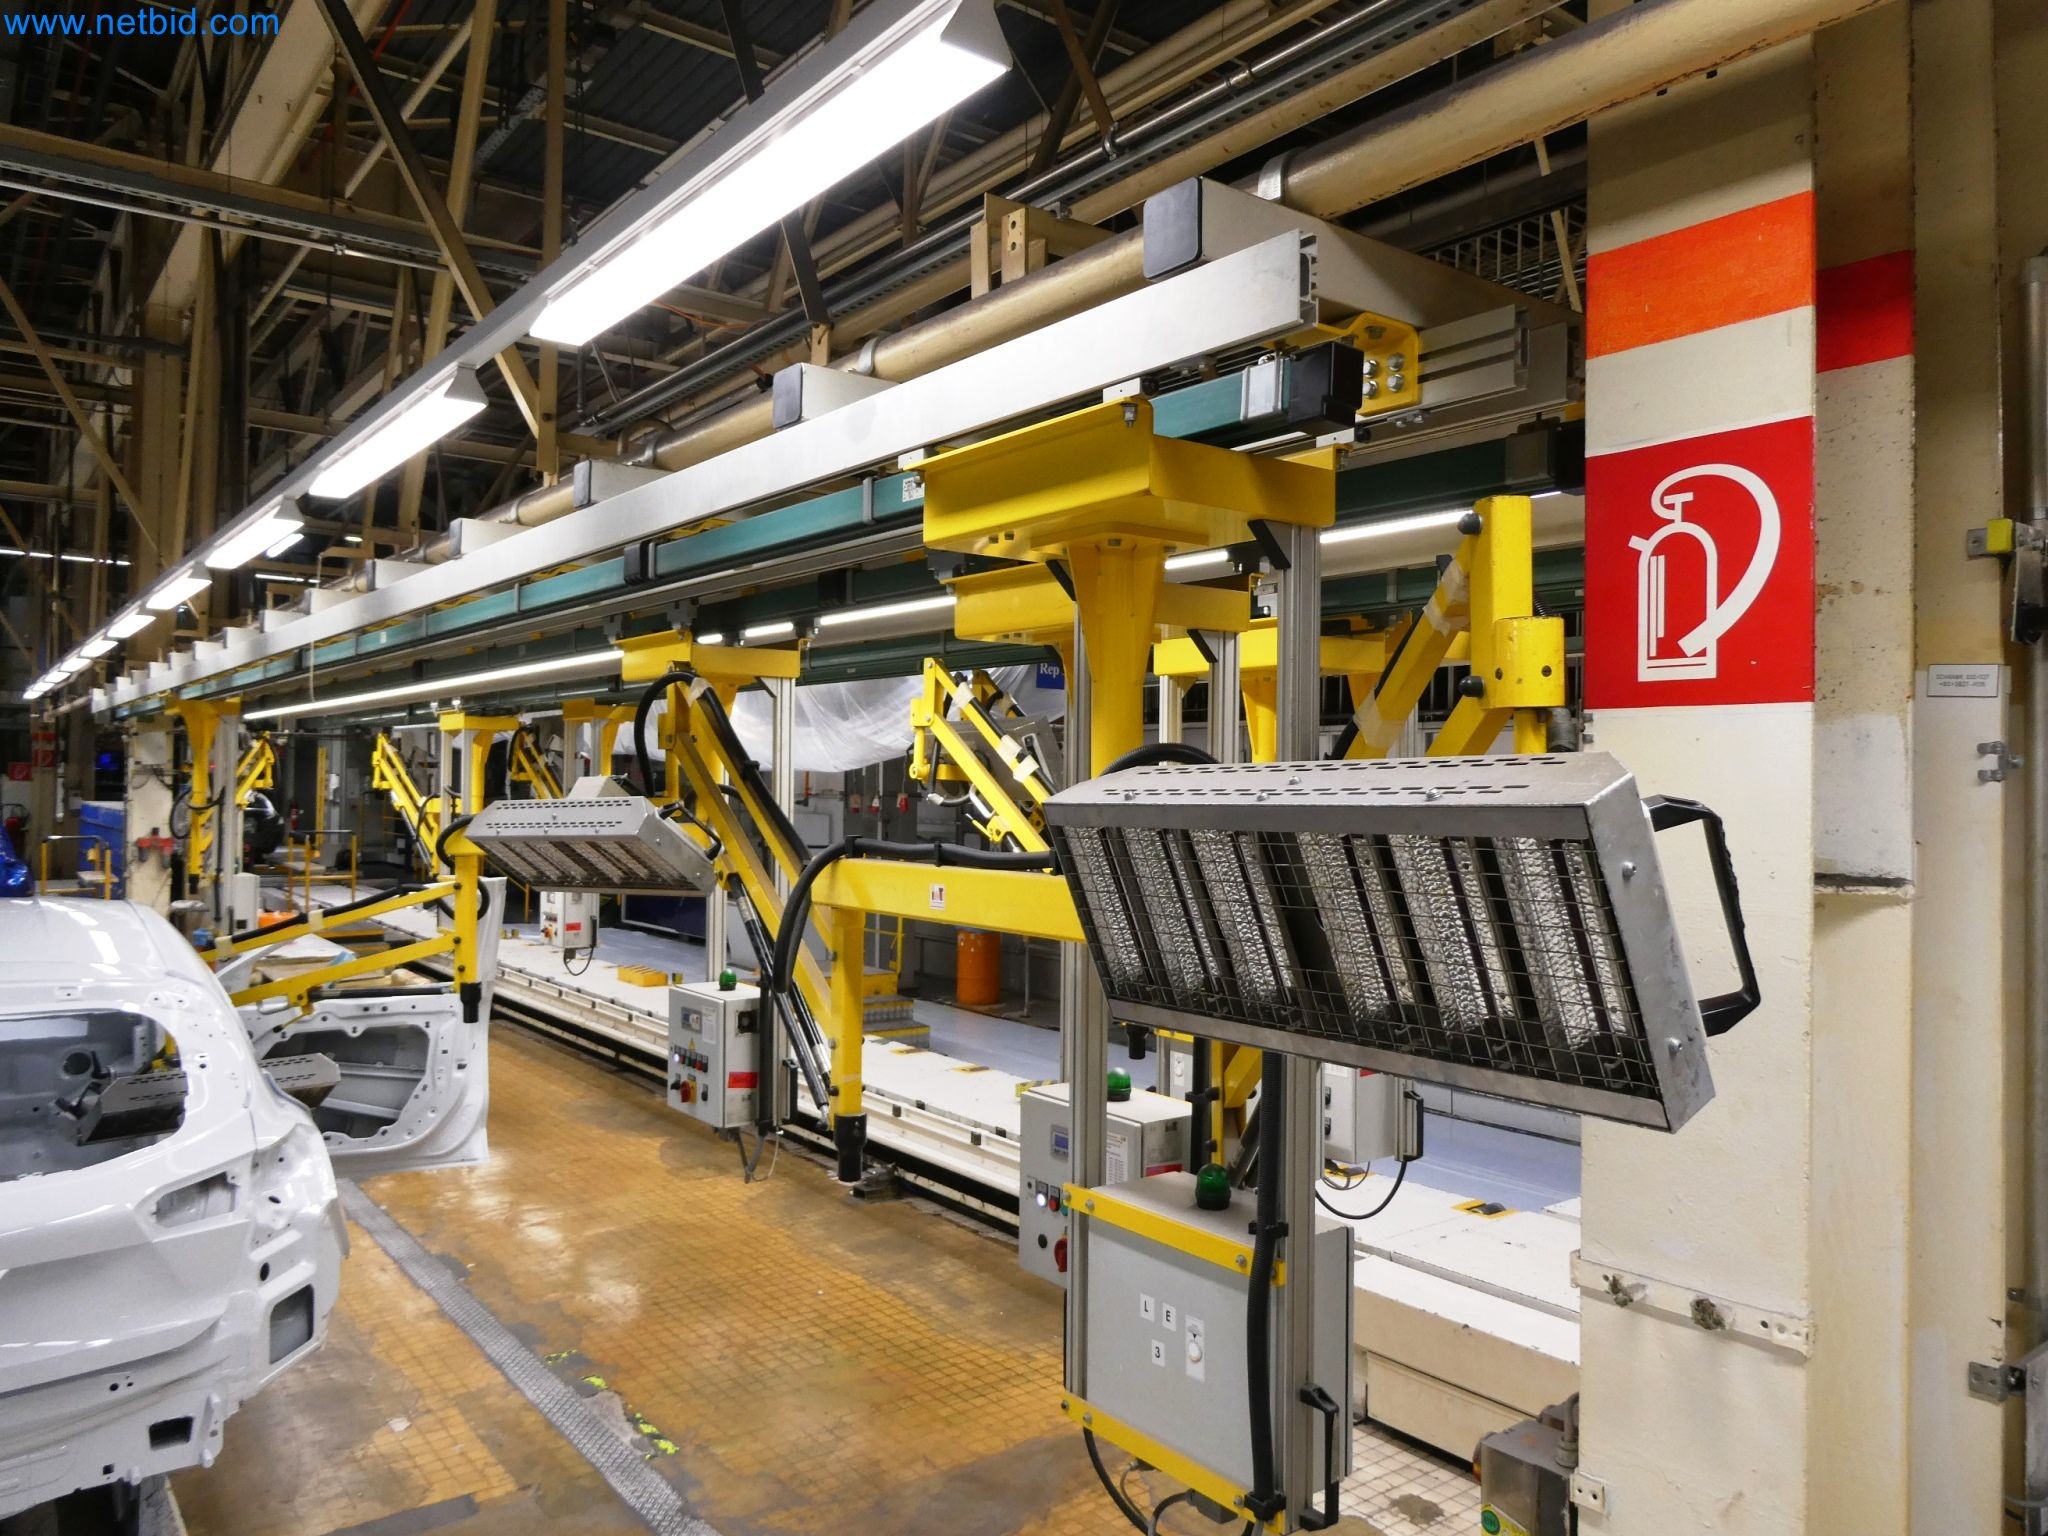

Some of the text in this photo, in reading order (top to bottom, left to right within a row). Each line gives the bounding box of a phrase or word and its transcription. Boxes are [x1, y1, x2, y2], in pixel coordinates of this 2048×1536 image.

[1144, 1299, 1171, 1322] L E
[1154, 1345, 1161, 1359] 3
